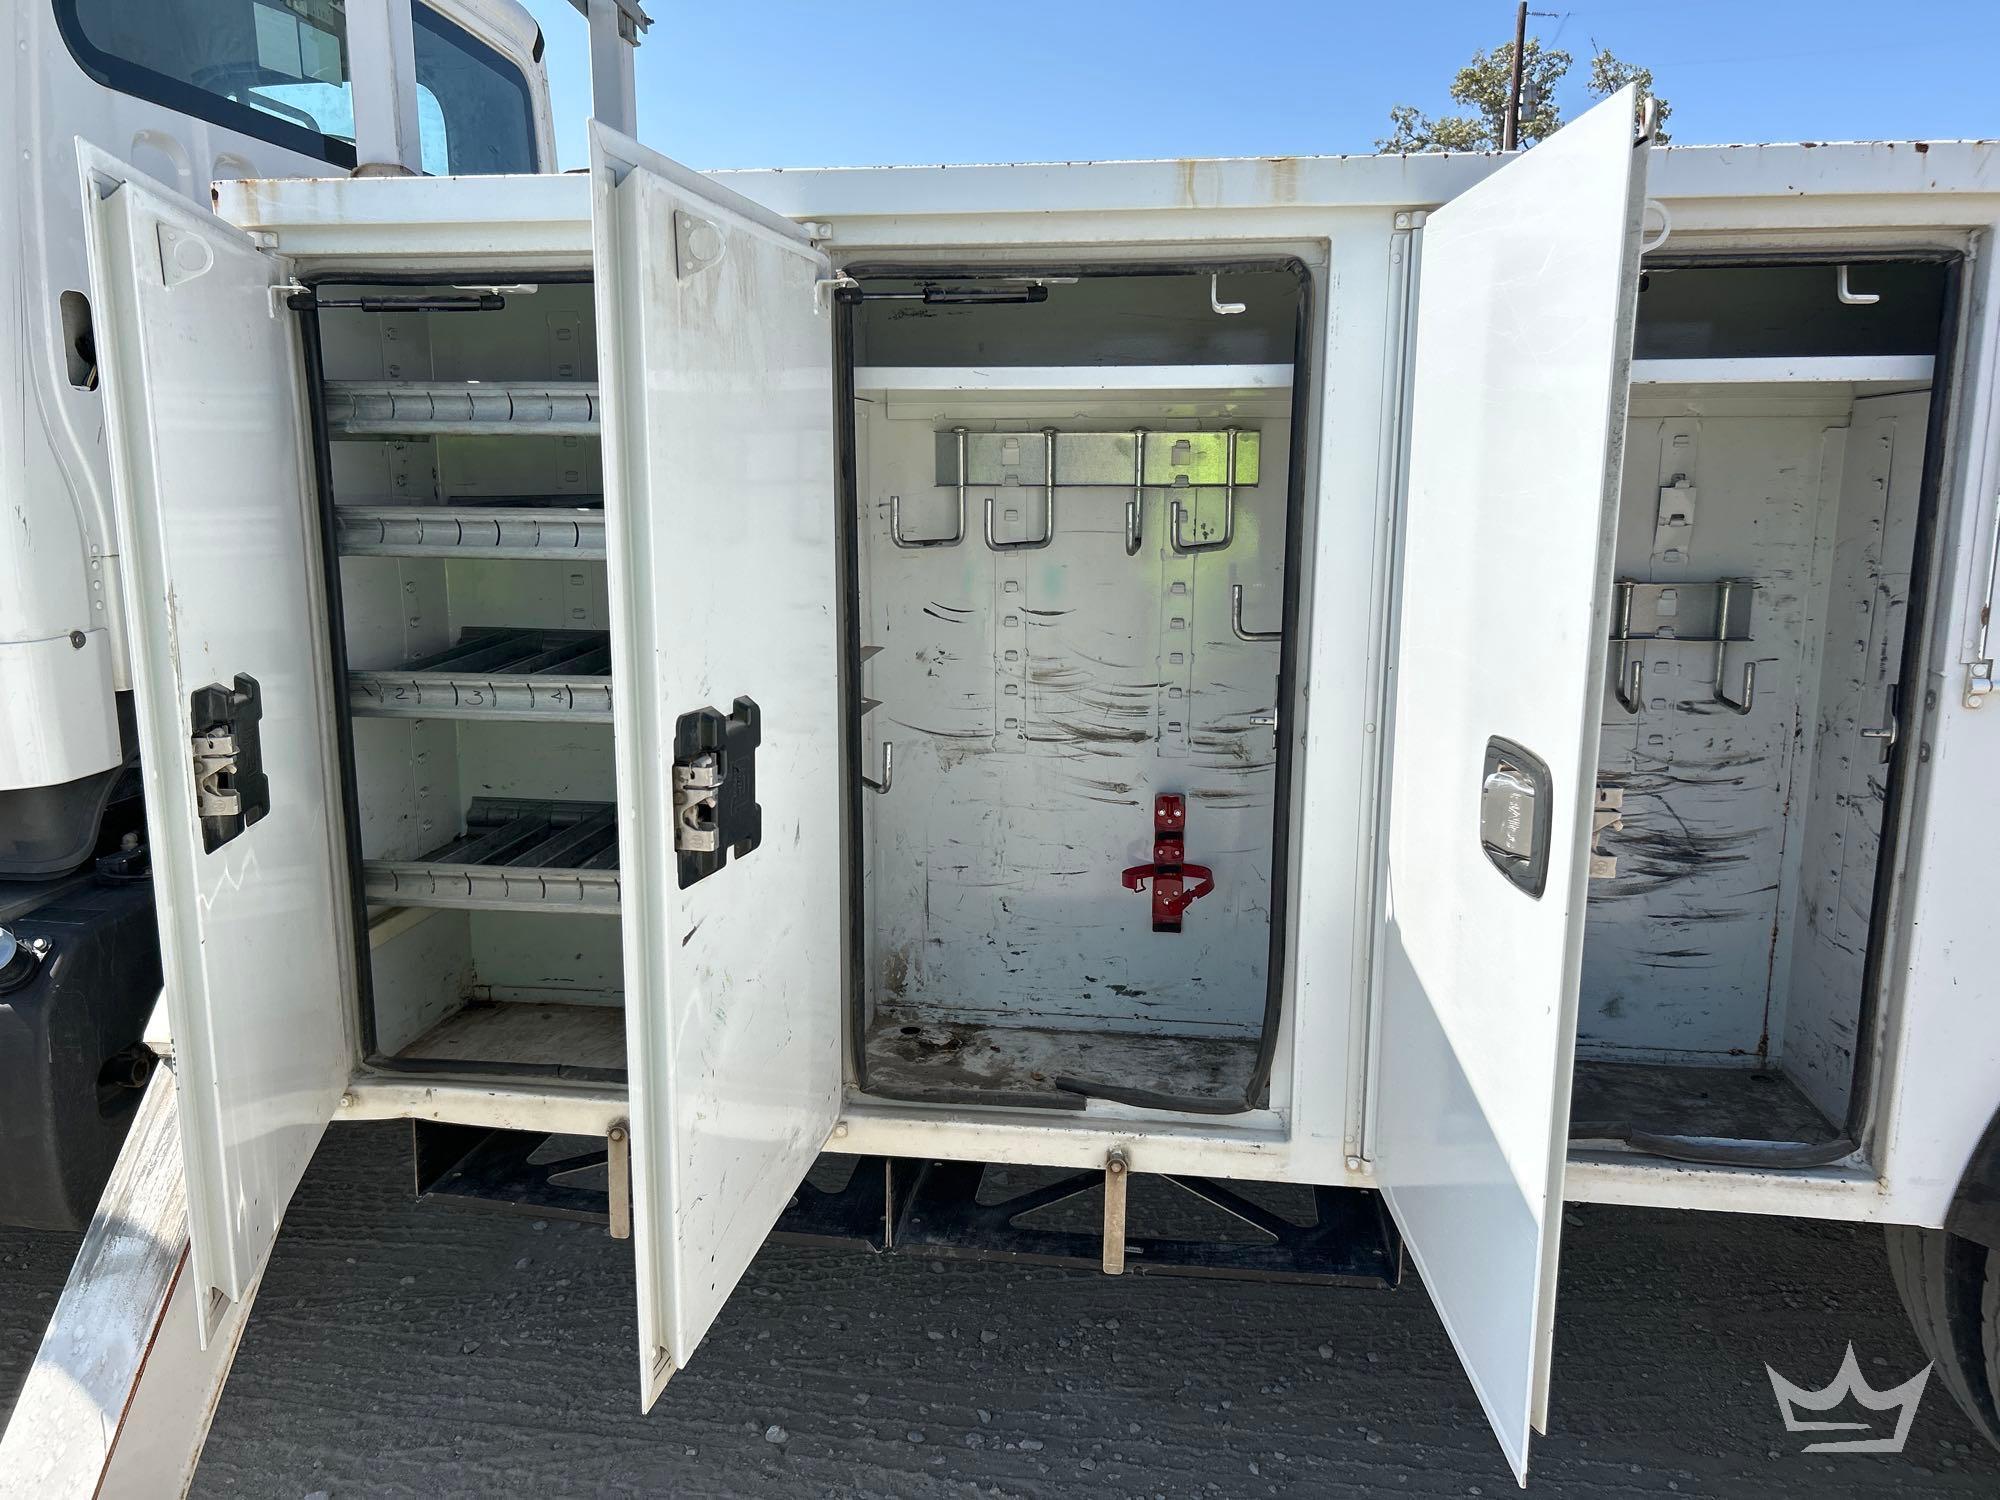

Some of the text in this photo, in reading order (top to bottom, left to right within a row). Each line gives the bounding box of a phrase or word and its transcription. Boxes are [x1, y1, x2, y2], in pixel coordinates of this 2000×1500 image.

[395, 687, 410, 700] 2
[464, 690, 484, 706] 3
[550, 688, 564, 703] 4
